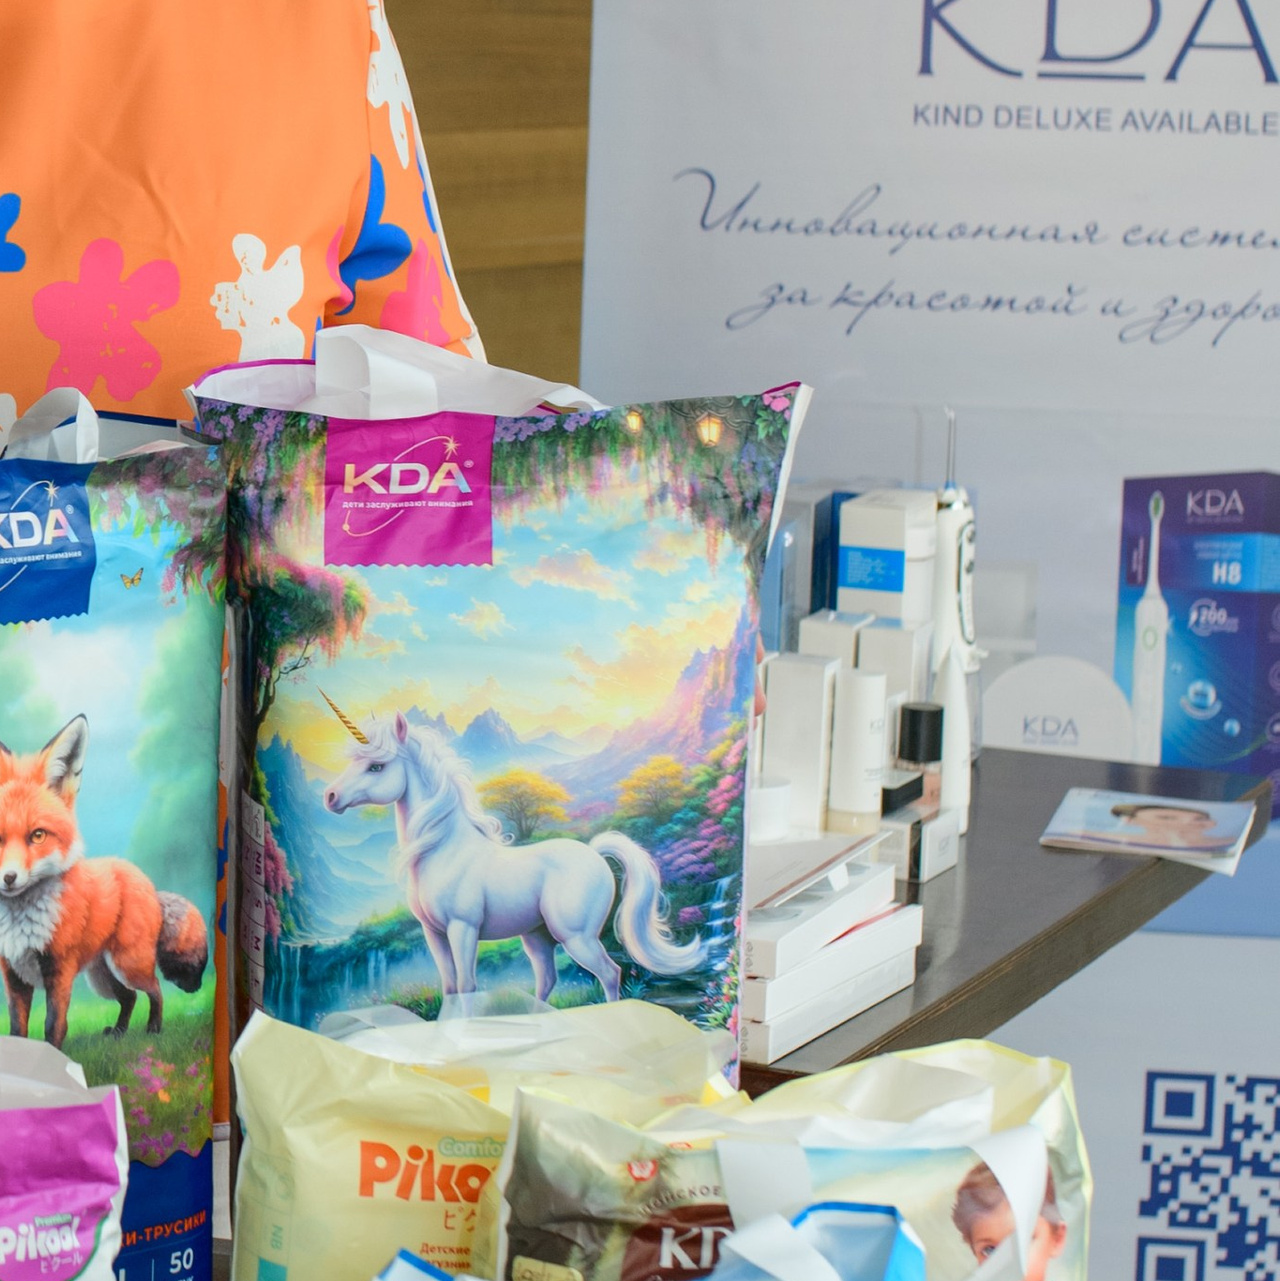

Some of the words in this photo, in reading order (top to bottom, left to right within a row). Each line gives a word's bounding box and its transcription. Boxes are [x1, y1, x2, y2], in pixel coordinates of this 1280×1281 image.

[913, 103, 984, 128] KIND
[994, 105, 1112, 132] DELUXE
[1120, 108, 1279, 136] AVAILABLE
[672, 167, 1108, 257] Инновационная
[725, 281, 819, 331] за
[828, 278, 1087, 337] красотой
[1100, 298, 1137, 318] и
[343, 462, 473, 495] KDA
[1186, 489, 1245, 516] KDA
[1022, 714, 1079, 737] KDA
[438, 1137, 506, 1158] Comfo
[359, 1140, 497, 1204] Piko
[121, 1209, 206, 1248] И-ТРУСИКИ
[169, 1247, 194, 1274] 50
